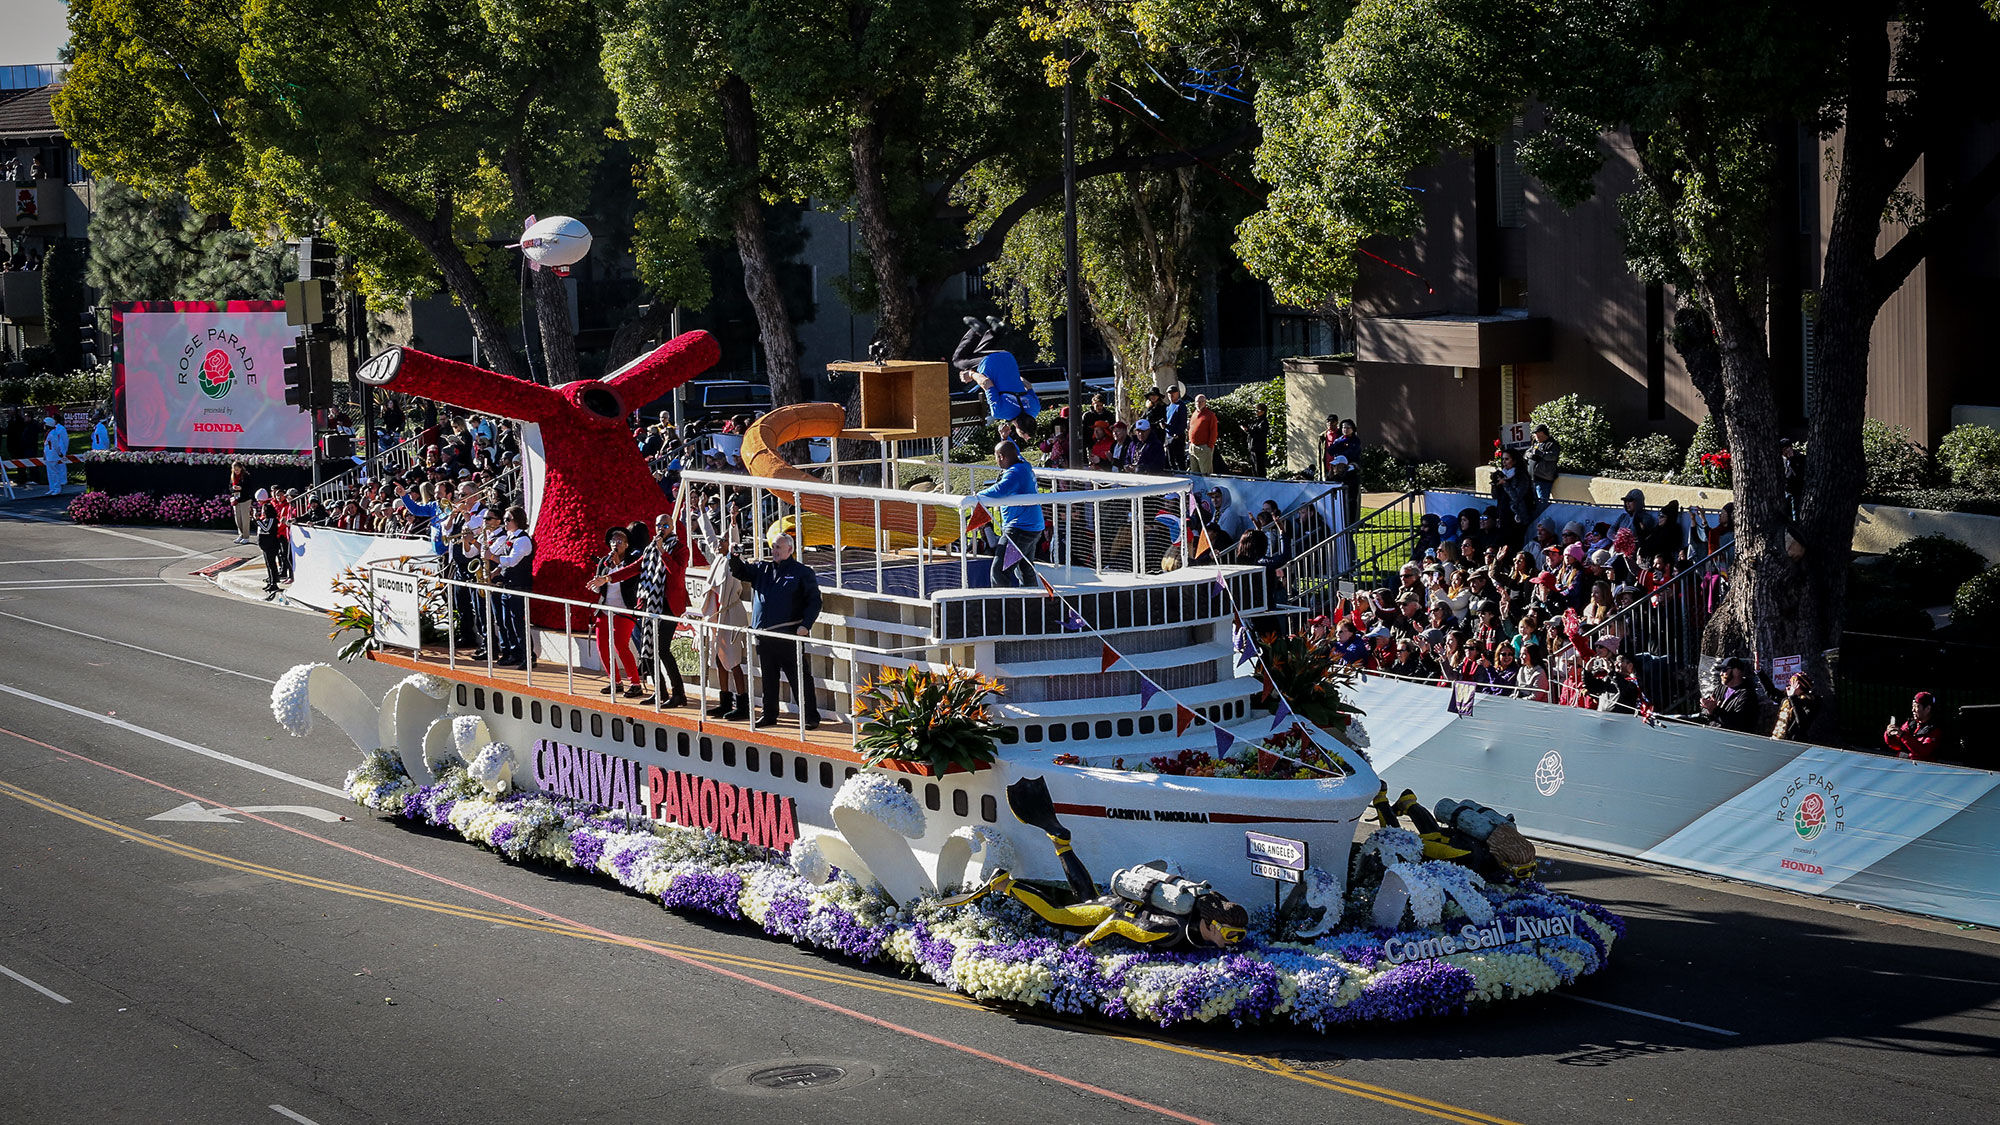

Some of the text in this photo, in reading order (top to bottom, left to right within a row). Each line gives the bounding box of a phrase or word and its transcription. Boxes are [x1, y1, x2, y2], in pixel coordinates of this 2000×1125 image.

[178, 328, 257, 385] ROSE PARADE
[203, 406, 233, 415] presented by
[193, 423, 244, 432] HONDA
[1510, 425, 1524, 442] 15
[377, 577, 413, 594] WELCOME TO
[531, 739, 799, 852] CARNIVAL PANORAMA
[1776, 773, 1845, 832] ROSE PARADE
[1106, 808, 1208, 824] CARNIVAL PANORAMA
[1253, 841, 1295, 859] LOS ANGELES
[1793, 847, 1818, 857] presented by
[1254, 864, 1280, 877] CHOOSE
[1780, 859, 1824, 875] HONDA
[1384, 914, 1575, 964] Come Sail Away
